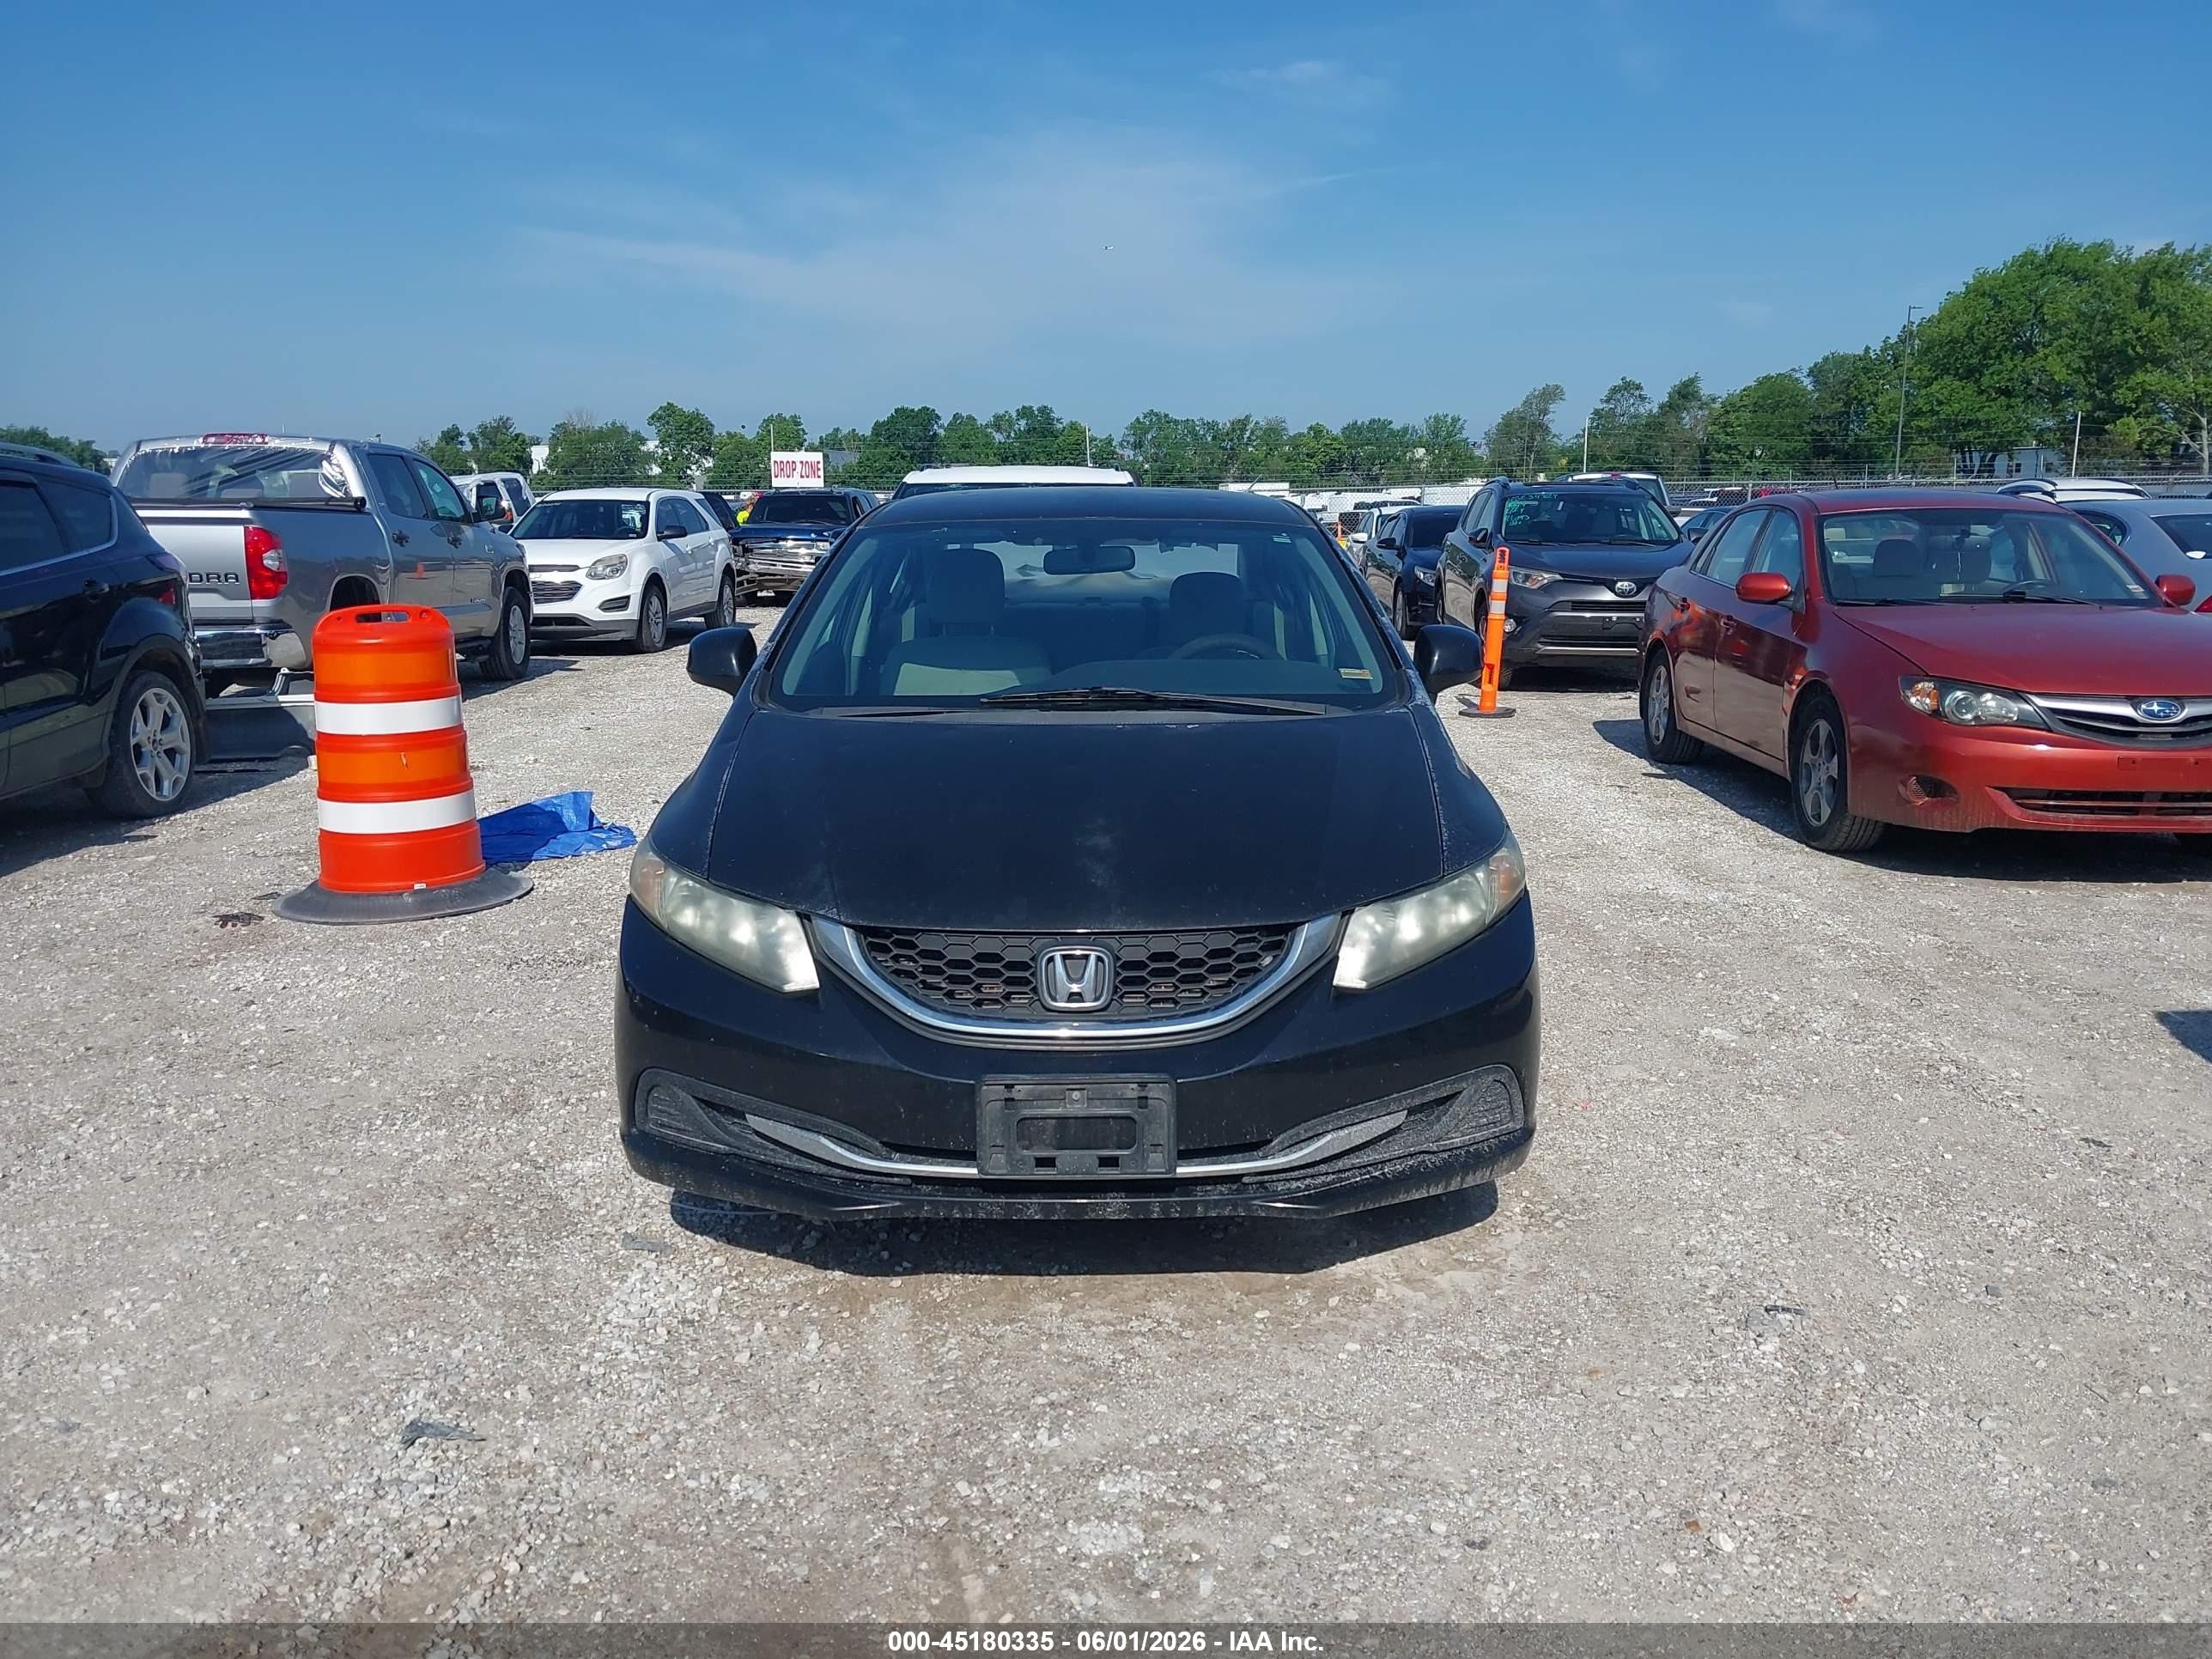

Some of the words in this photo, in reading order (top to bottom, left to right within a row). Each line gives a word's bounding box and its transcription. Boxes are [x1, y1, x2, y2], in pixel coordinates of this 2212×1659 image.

[773, 460, 797, 478] DROP
[799, 460, 822, 479] ZONE
[188, 572, 240, 585] DRA
